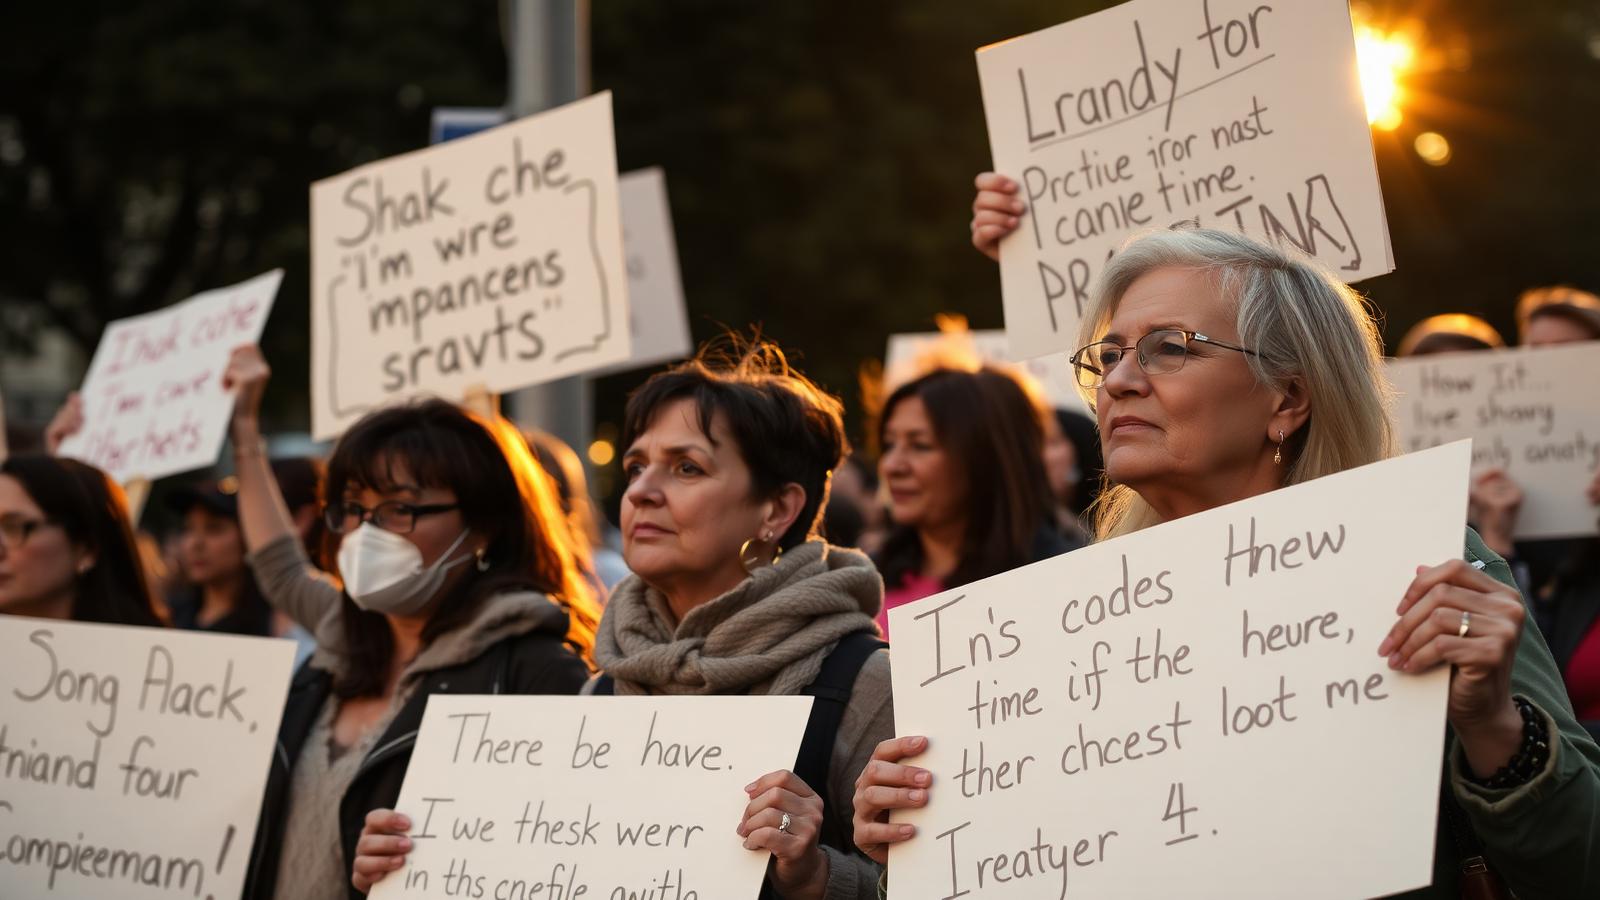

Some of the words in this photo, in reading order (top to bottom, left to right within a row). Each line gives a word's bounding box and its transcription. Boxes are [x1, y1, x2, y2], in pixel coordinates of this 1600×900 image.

[1018, 20, 1182, 144] Lrandy
[1212, 96, 1274, 151] nast
[335, 167, 455, 248] Shak
[484, 136, 574, 206] che
[1156, 164, 1256, 214] time.
[433, 210, 519, 264] wre
[1061, 554, 1176, 634] codes
[13, 629, 119, 737] Song
[967, 679, 1043, 729] time
[1125, 627, 1194, 685] the
[1241, 610, 1355, 659] heure,
[119, 735, 200, 800] four
[447, 711, 544, 765] There
[571, 715, 611, 770] be
[640, 710, 734, 771] have.
[952, 741, 1036, 799] ther
[1221, 675, 1297, 737] loot
[1326, 669, 1390, 708] me
[411, 798, 455, 839] I
[452, 816, 496, 843] we
[514, 800, 600, 847] thesk
